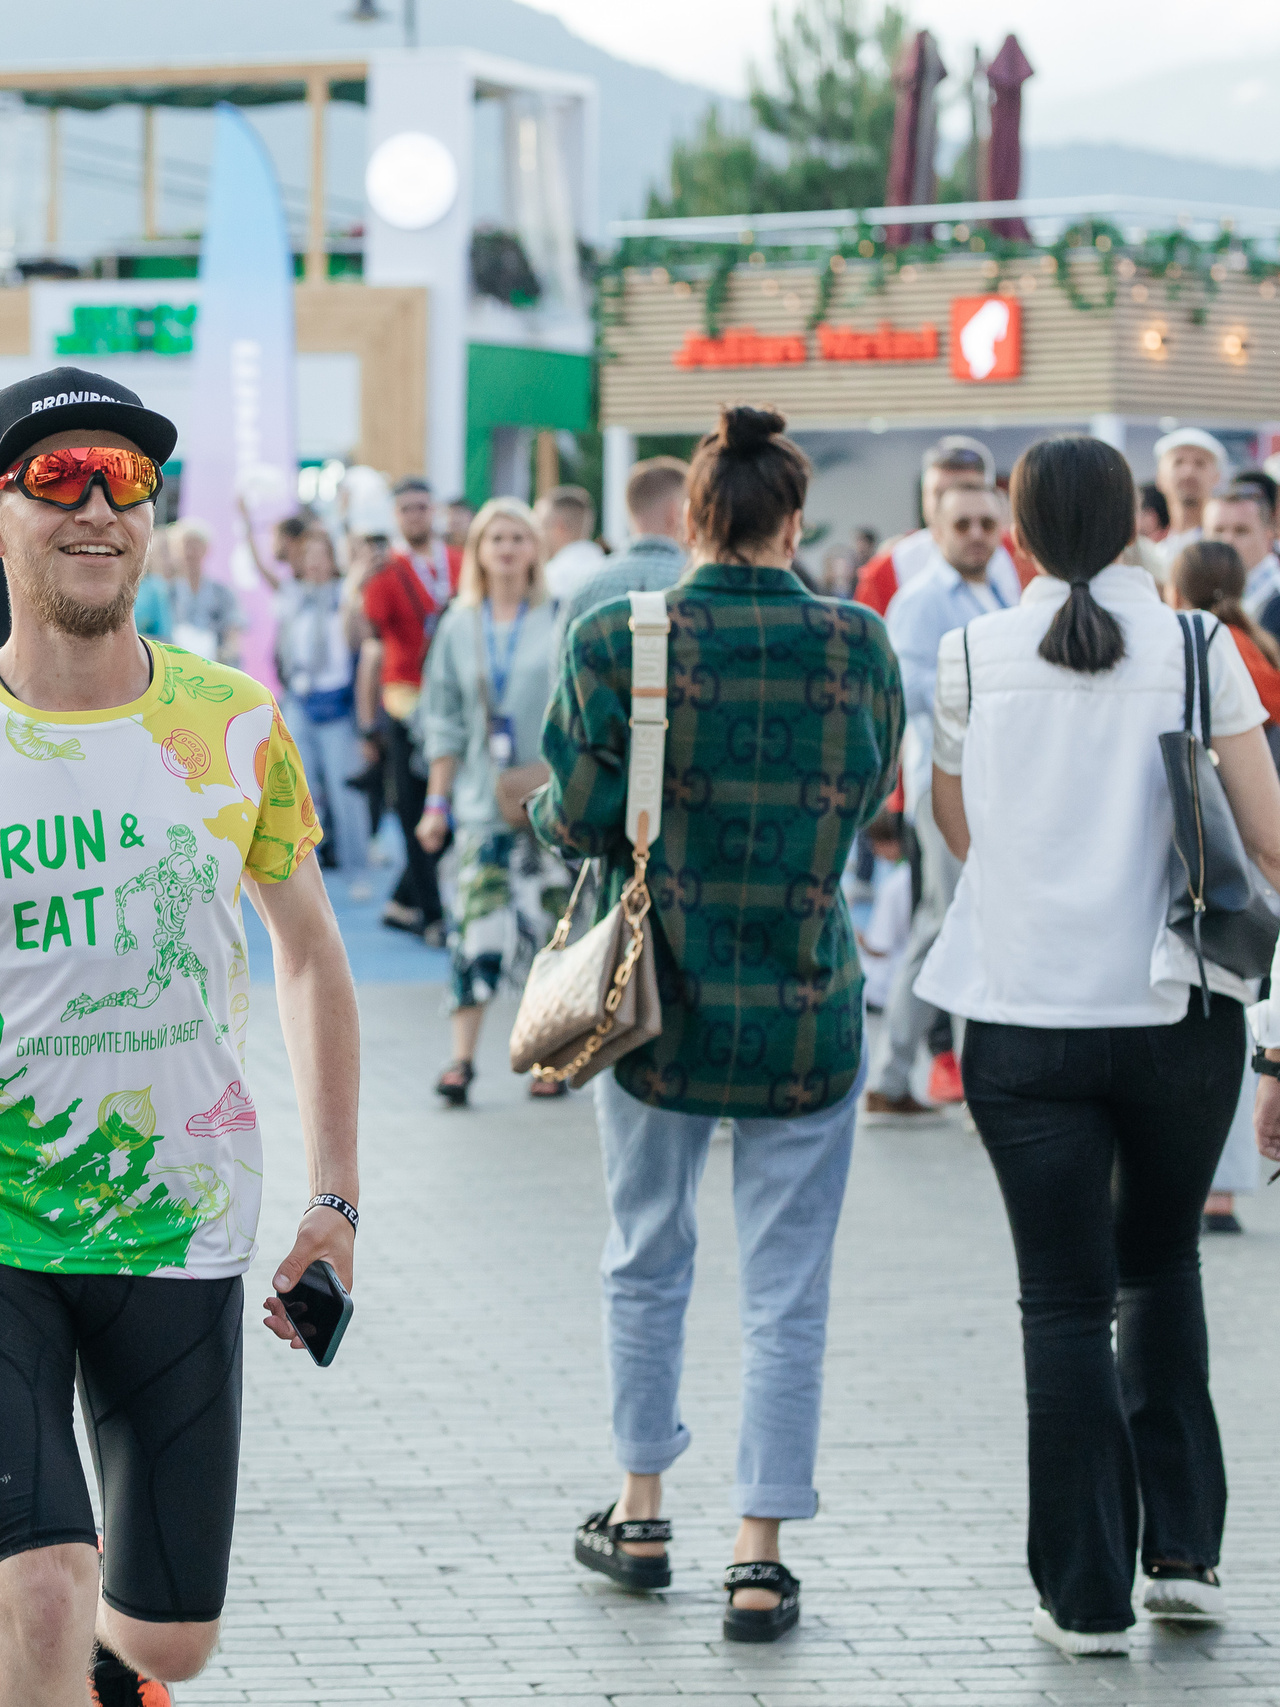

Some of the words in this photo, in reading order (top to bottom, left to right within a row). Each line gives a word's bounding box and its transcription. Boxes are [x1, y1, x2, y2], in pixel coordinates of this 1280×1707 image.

[32, 391, 121, 414] BRONIB
[0, 809, 106, 879] RUN
[120, 812, 145, 849] &
[13, 886, 104, 953] EAT
[16, 1023, 168, 1057] БЛАГОТВОРИТЕЛЬНЫЙ
[169, 1019, 204, 1046] ЗАБЕГ
[308, 1194, 343, 1209] TREET
